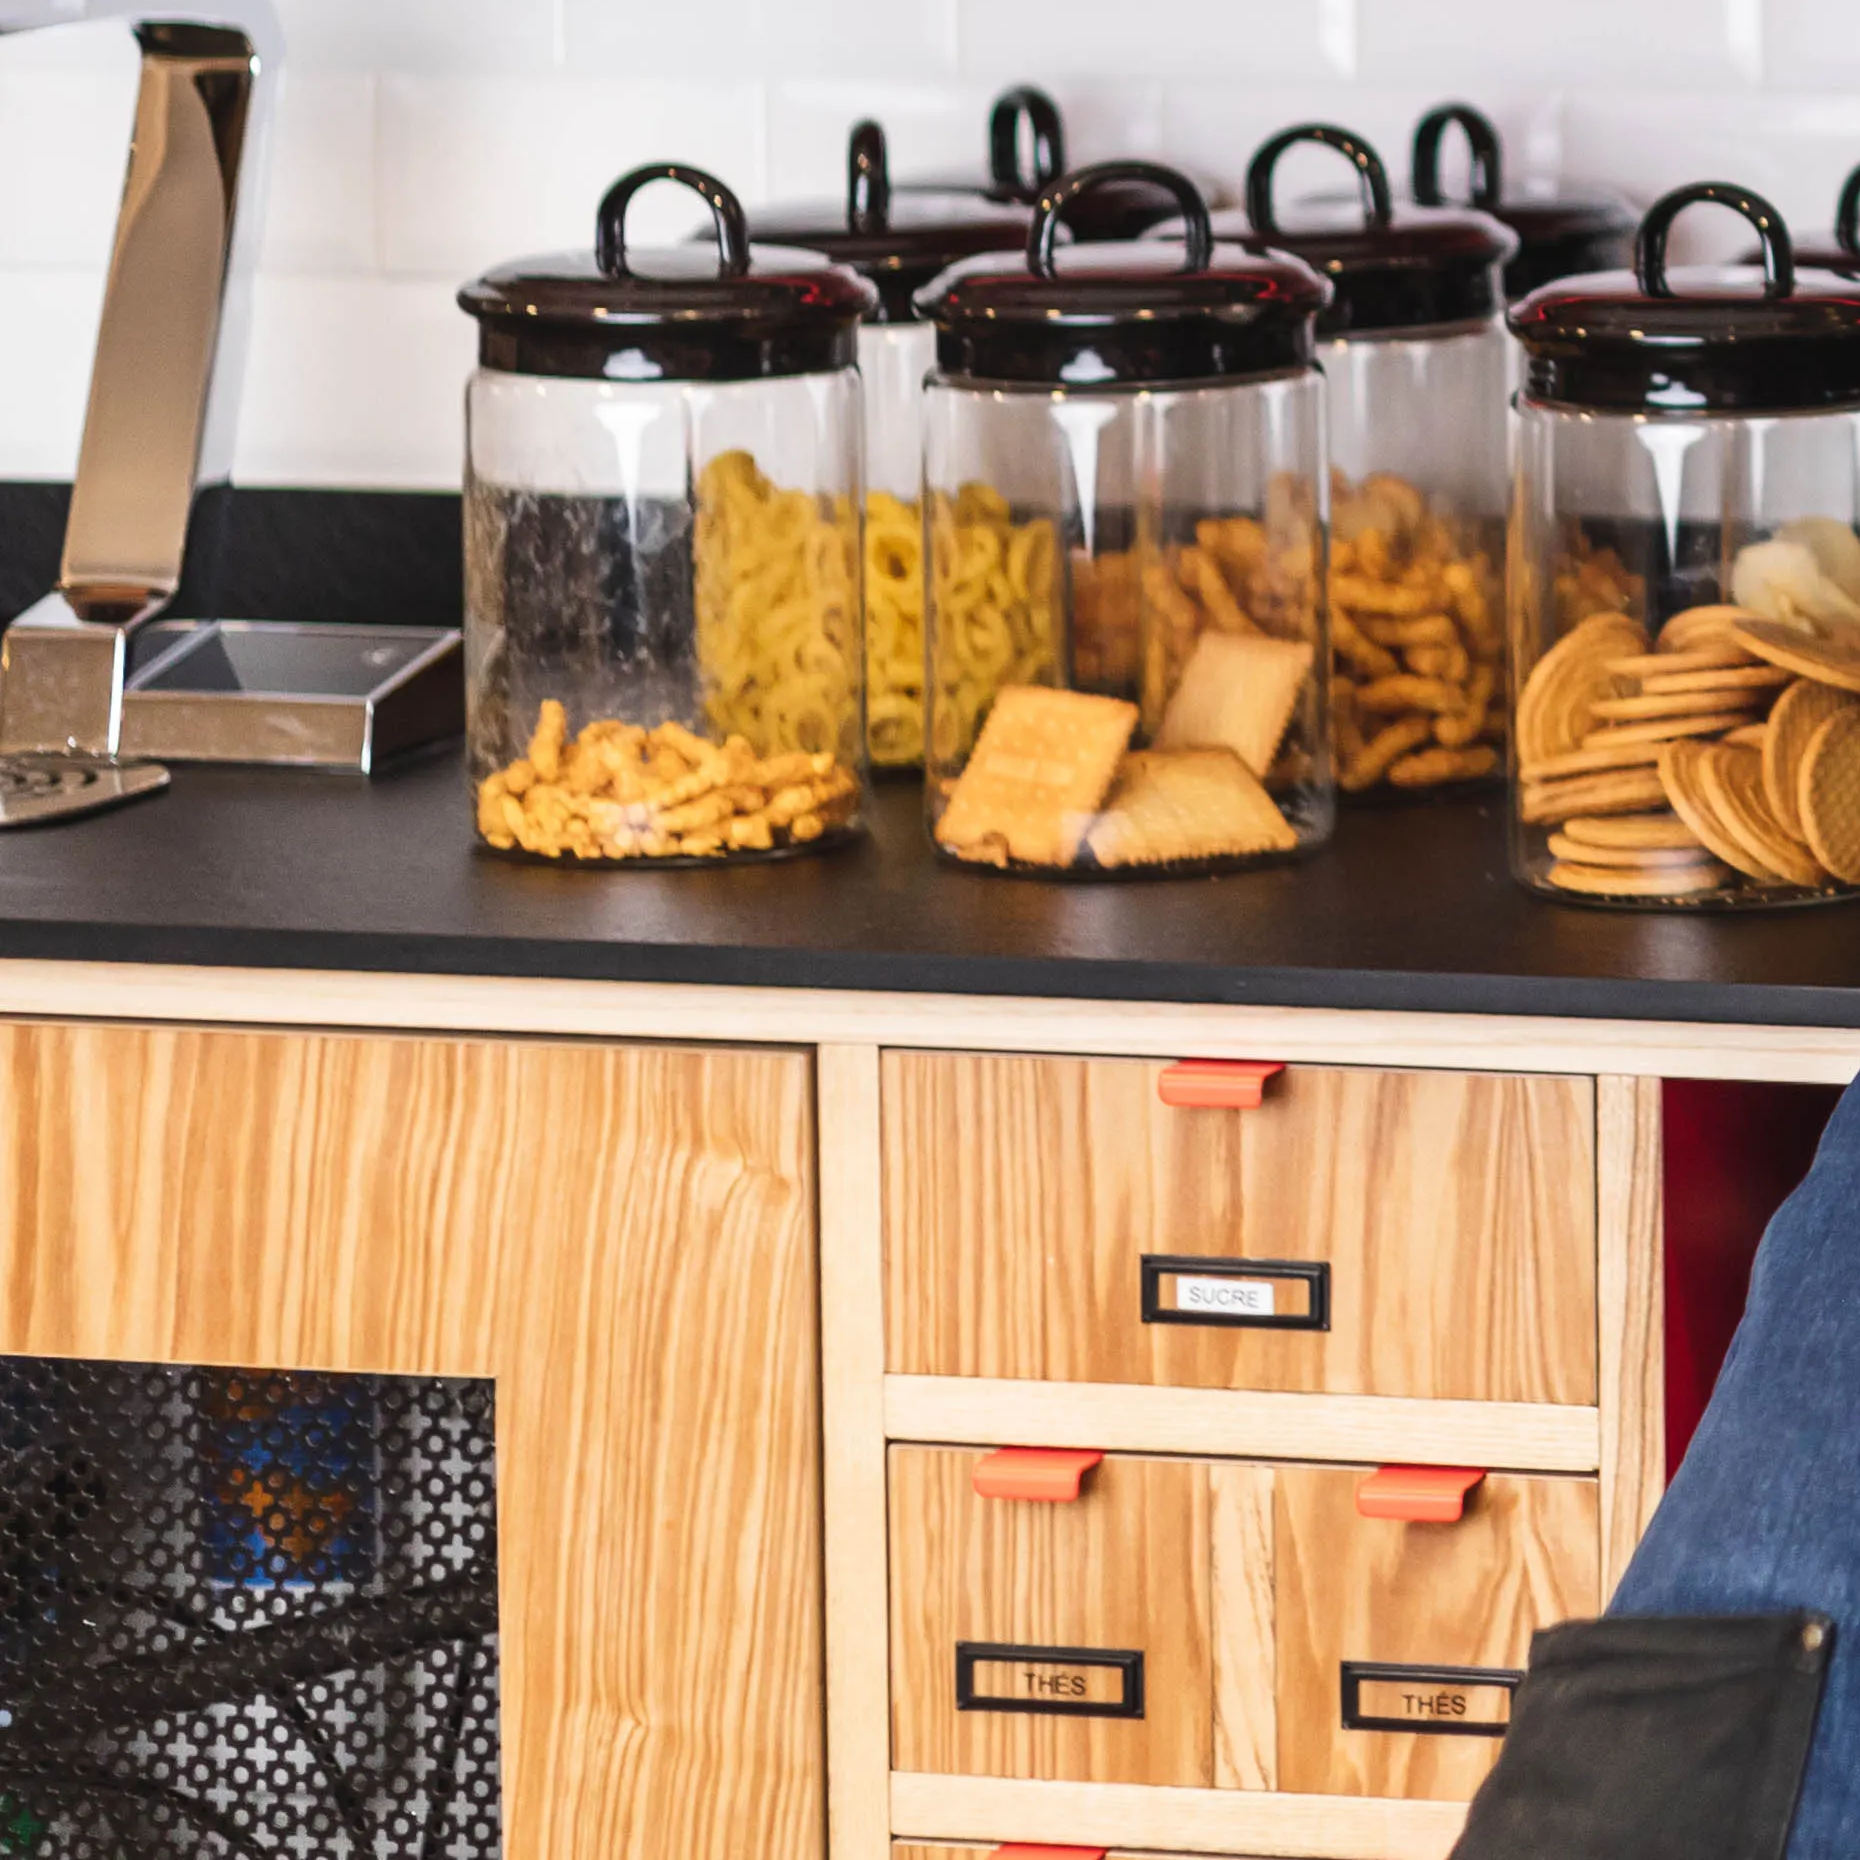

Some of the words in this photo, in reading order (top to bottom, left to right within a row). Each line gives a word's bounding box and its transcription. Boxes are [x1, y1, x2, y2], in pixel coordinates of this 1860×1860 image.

[1188, 1285, 1260, 1309] SUCRE
[1023, 1671, 1087, 1697] THÉS
[1402, 1691, 1467, 1716] THÉS
